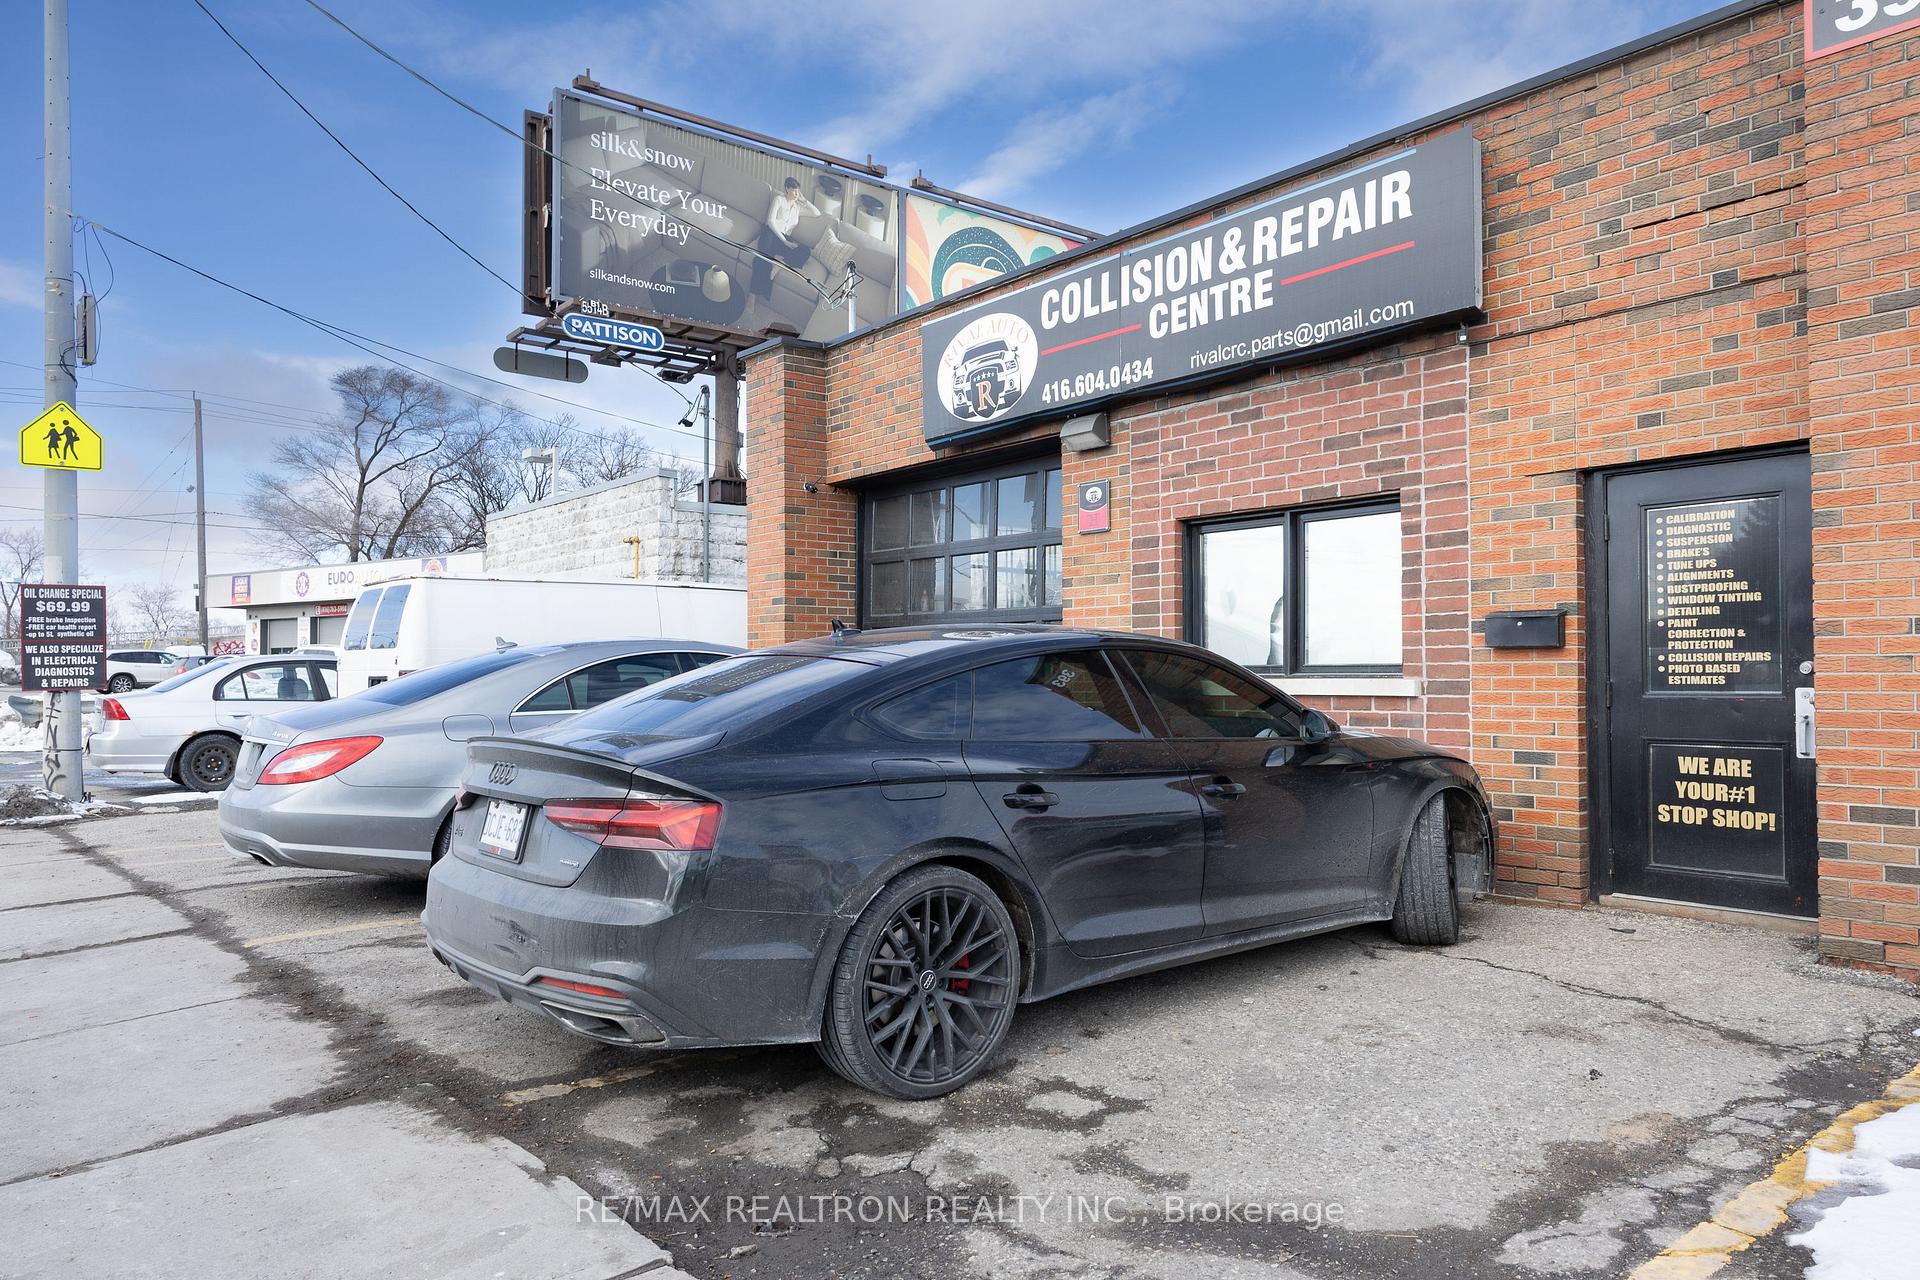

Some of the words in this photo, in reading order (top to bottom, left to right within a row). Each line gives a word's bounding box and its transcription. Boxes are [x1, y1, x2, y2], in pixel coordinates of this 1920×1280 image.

[590, 131, 695, 173] silk&snow
[590, 167, 671, 206] Elevate
[676, 189, 727, 219] Your
[590, 198, 692, 245] Everyday
[1040, 236, 1212, 331] COLLISION
[1218, 226, 1247, 275] &
[1252, 169, 1413, 267] REPAIR
[589, 268, 676, 295] silkandsnow.com
[1148, 268, 1274, 340] CENTRE
[571, 318, 657, 346] PATTISON
[1190, 298, 1415, 370] rivalcrc.parts@gmail.com
[1041, 356, 1154, 405] 416.604.0434
[975, 380, 997, 412] R
[1666, 509, 1736, 524] CALIBRATION
[1666, 521, 1731, 536] DIAGNOSTIC
[1666, 533, 1733, 547] SUSPENSION
[1666, 547, 1710, 558] BRAKE'S
[1667, 560, 1694, 570] TUNE
[1695, 558, 1717, 569] UPS
[1667, 569, 1735, 582] ALIGNMENTS
[24, 588, 37, 599] OIL
[38, 588, 70, 599] CHANGE
[71, 588, 103, 600] SPECIAL
[1667, 581, 1749, 594] RUSTPROOFING
[1667, 594, 1715, 605] WINDOW
[1717, 592, 1762, 603] TINTING
[36, 600, 91, 613] $69.99
[1667, 605, 1721, 617] DETAILING
[1667, 618, 1698, 628] PAINT
[57, 630, 85, 639] synthetic
[1667, 628, 1735, 639] CORRECTION
[1737, 628, 1746, 637] &
[25, 645, 38, 654] WE
[39, 645, 59, 654] ALSO
[61, 644, 104, 654] SPECIALIZE
[1667, 640, 1734, 650] PROTECTION
[31, 656, 41, 666] IN
[44, 656, 98, 666] ELECTRICAL
[1668, 652, 1722, 662] COLLISION
[1724, 651, 1772, 661] REPAIRS
[34, 667, 95, 677] DIAGNOSTICS
[1668, 664, 1703, 673] PHOTO
[1705, 664, 1741, 673] BASED
[41, 679, 49, 688] &
[51, 678, 89, 688] REPAIRS
[1668, 675, 1726, 685] ESTIMATES
[1677, 755, 1709, 776] WE
[1713, 757, 1752, 778] ARE
[1675, 780, 1755, 804] YOUR#1
[1657, 804, 1708, 825] STOP
[1712, 808, 1776, 832] SHOP!
